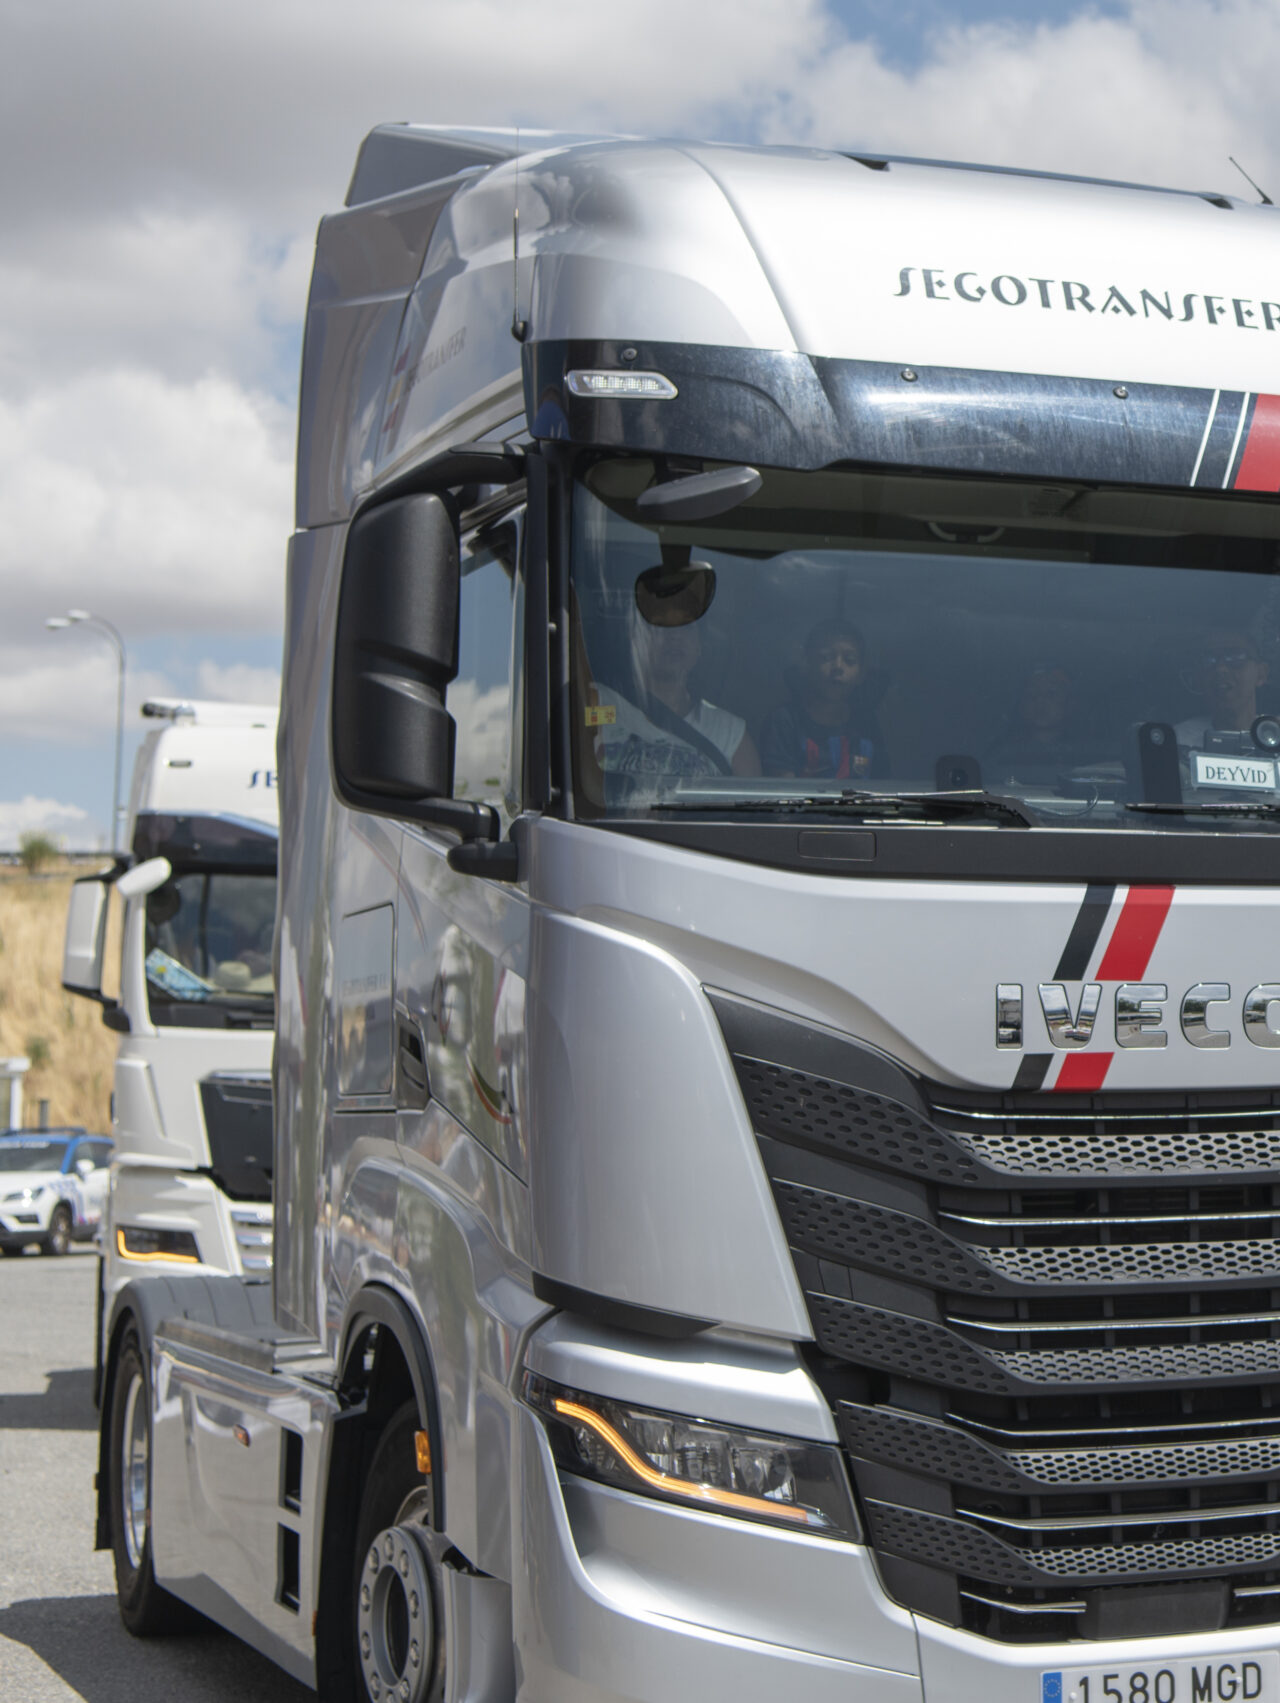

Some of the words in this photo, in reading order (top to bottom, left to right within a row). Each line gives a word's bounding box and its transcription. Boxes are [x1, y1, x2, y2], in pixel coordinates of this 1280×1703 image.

[1205, 766, 1267, 784] DEYVID
[1079, 1669, 1176, 1703] 1580
[1191, 1661, 1262, 1703] MGD
